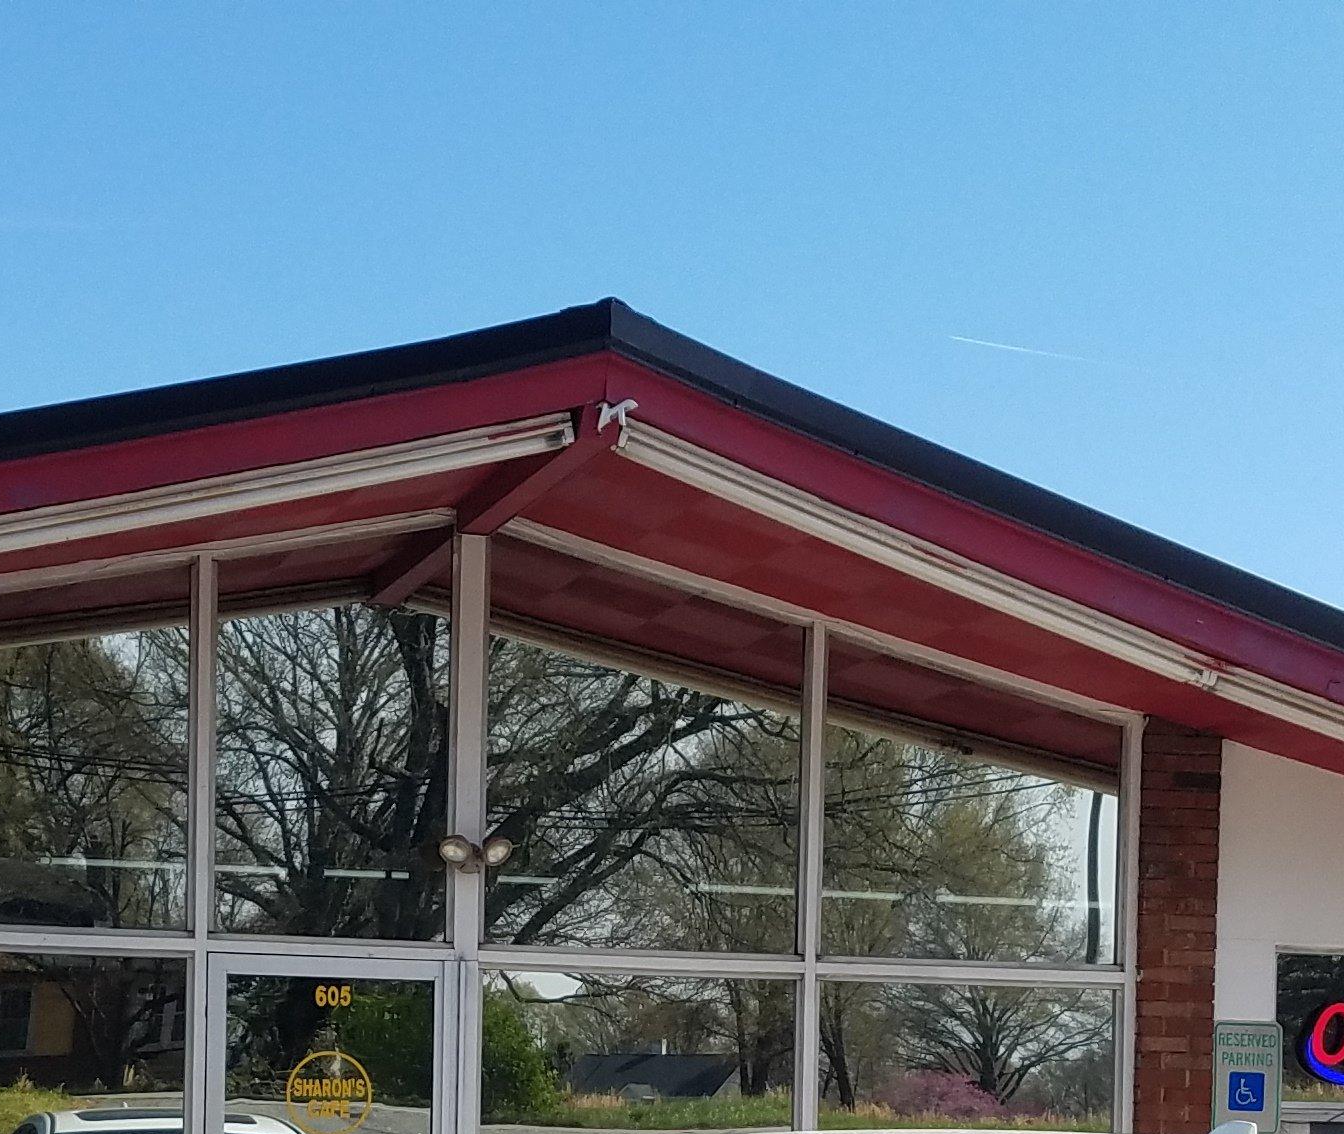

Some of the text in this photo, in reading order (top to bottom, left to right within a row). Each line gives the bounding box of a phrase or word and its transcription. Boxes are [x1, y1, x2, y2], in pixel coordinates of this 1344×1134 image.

[315, 985, 352, 1007] 605
[1218, 1032, 1276, 1048] RESERVED
[1222, 1051, 1273, 1067] PARKING
[293, 1078, 366, 1098] SHARON'S
